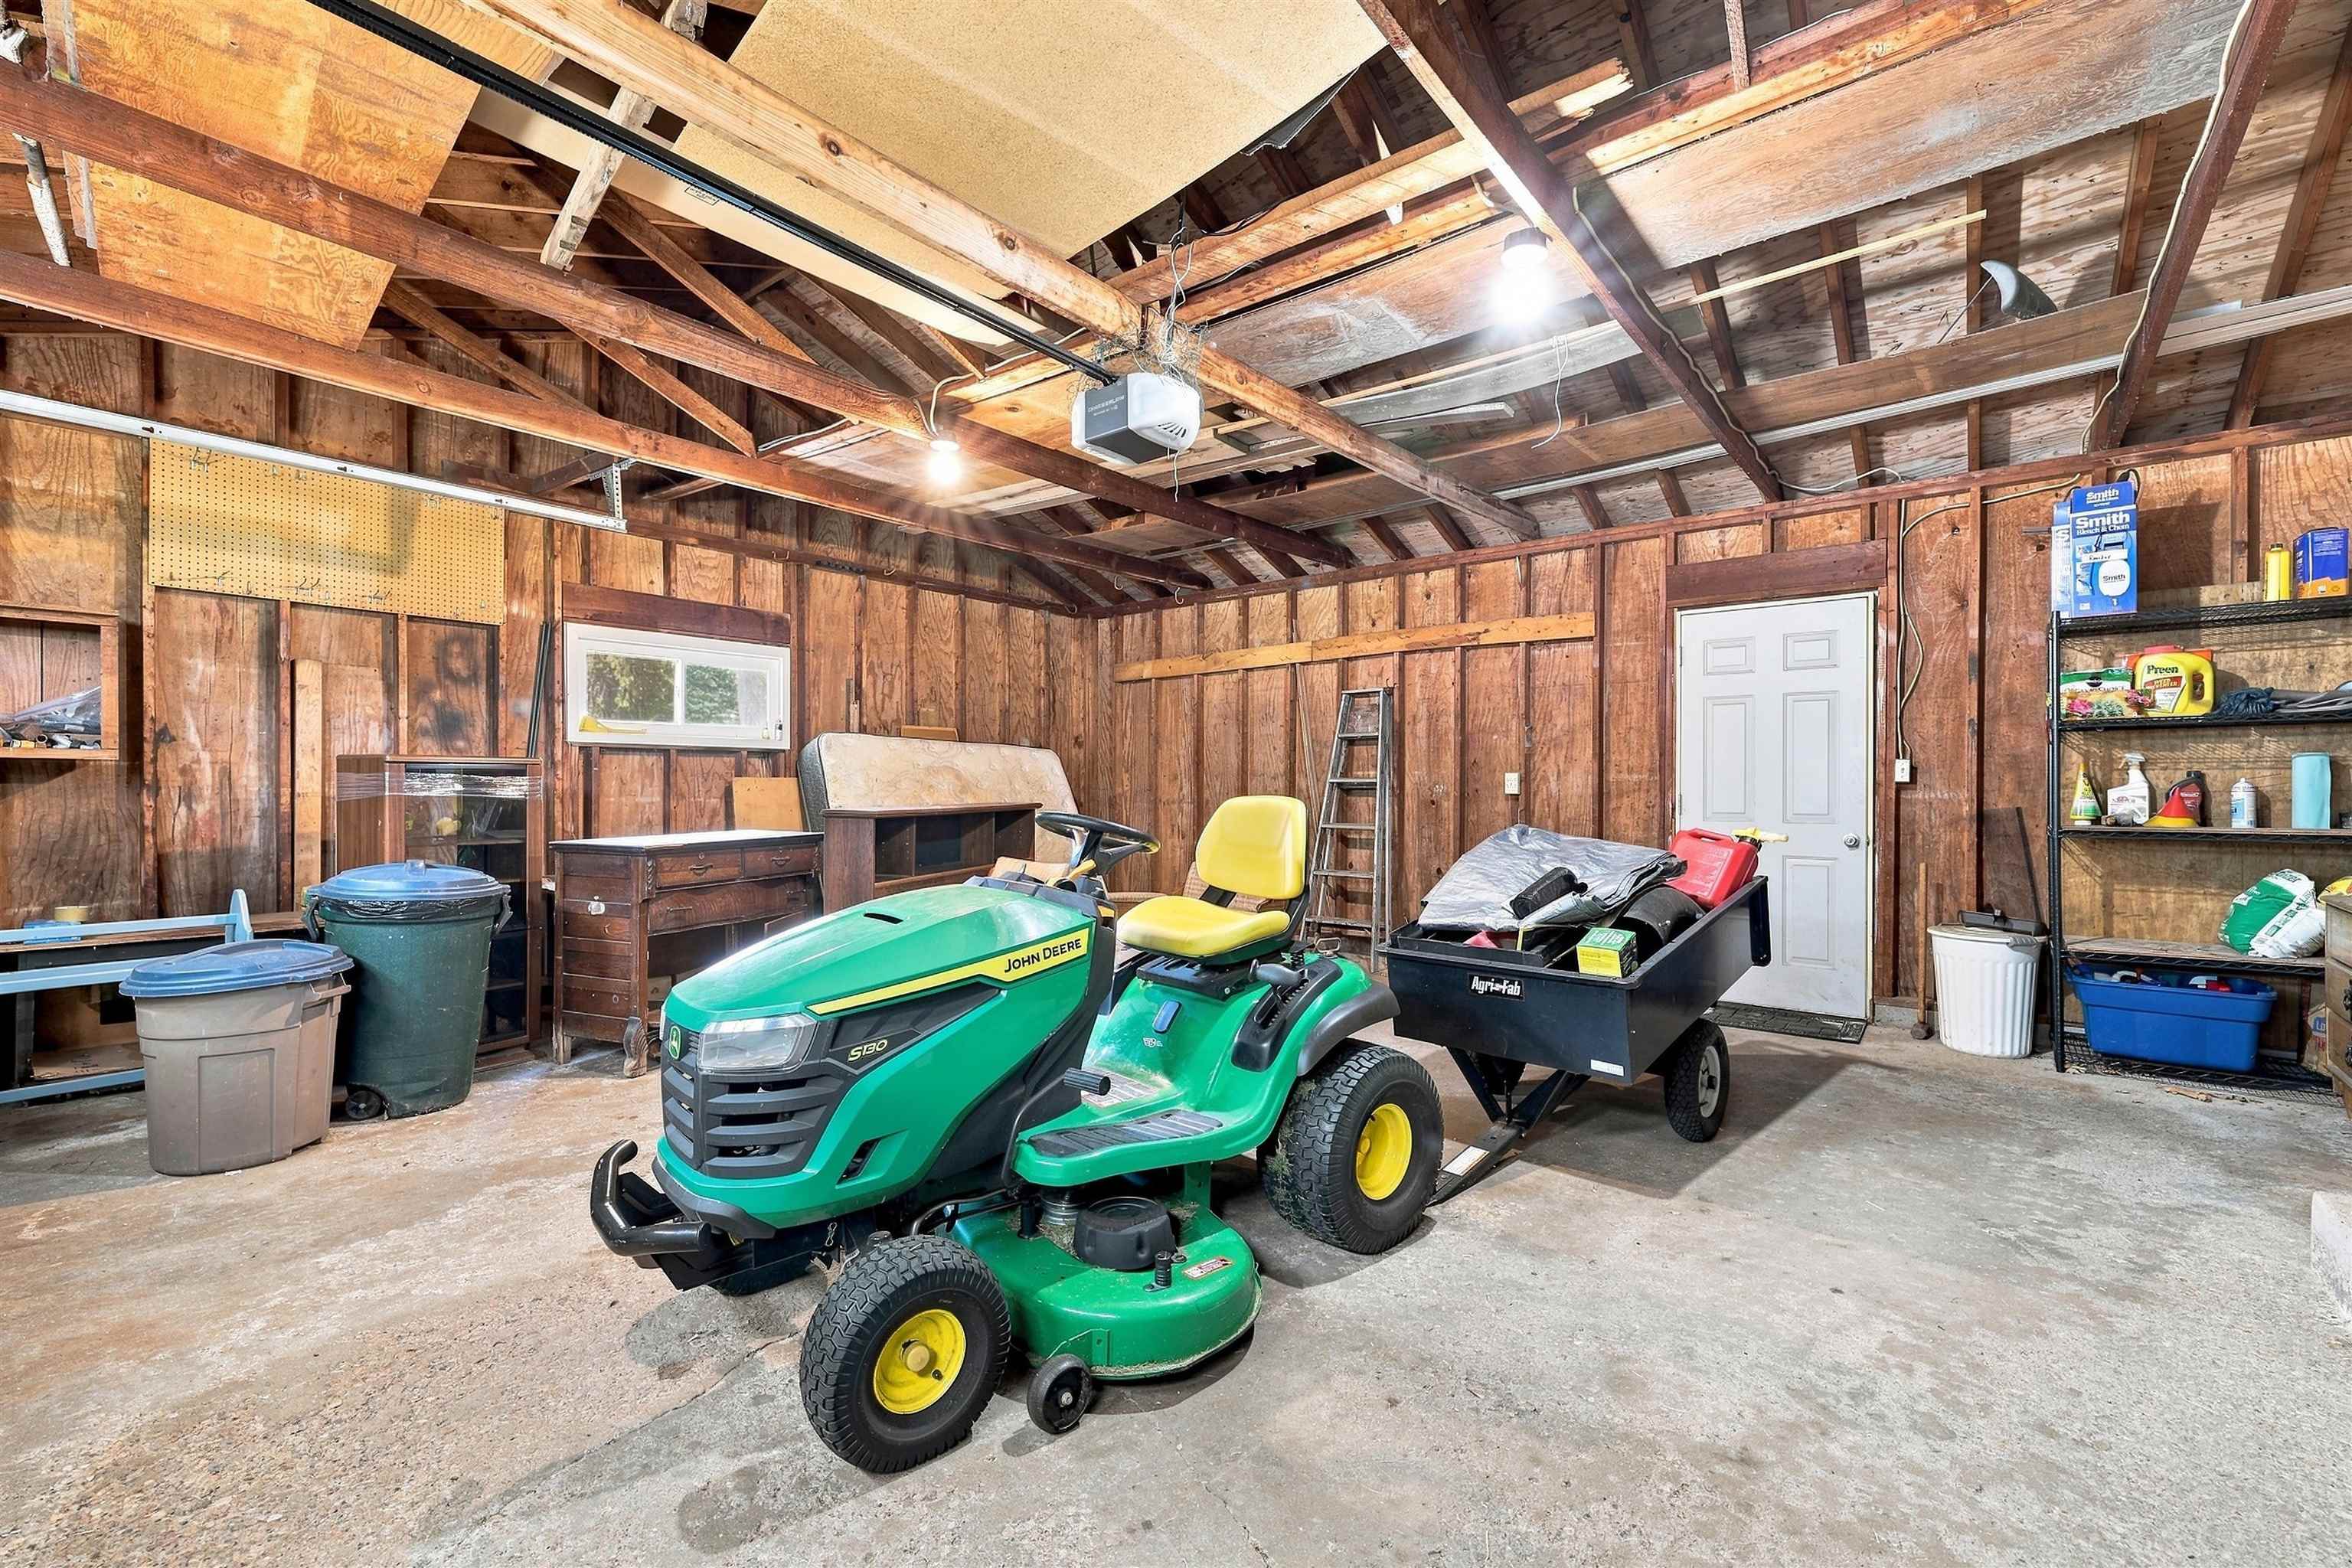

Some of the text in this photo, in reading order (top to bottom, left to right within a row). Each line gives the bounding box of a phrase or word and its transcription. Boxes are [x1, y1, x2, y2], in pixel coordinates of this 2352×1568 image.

[2086, 488, 2119, 500] Smith
[2076, 511, 2130, 529] Smith
[2109, 523, 2130, 532] Chem
[2102, 573, 2126, 582] Smith
[2147, 665, 2179, 675] Preen
[1004, 938, 1082, 973] JOHN DEERE
[847, 1039, 888, 1061] S130
